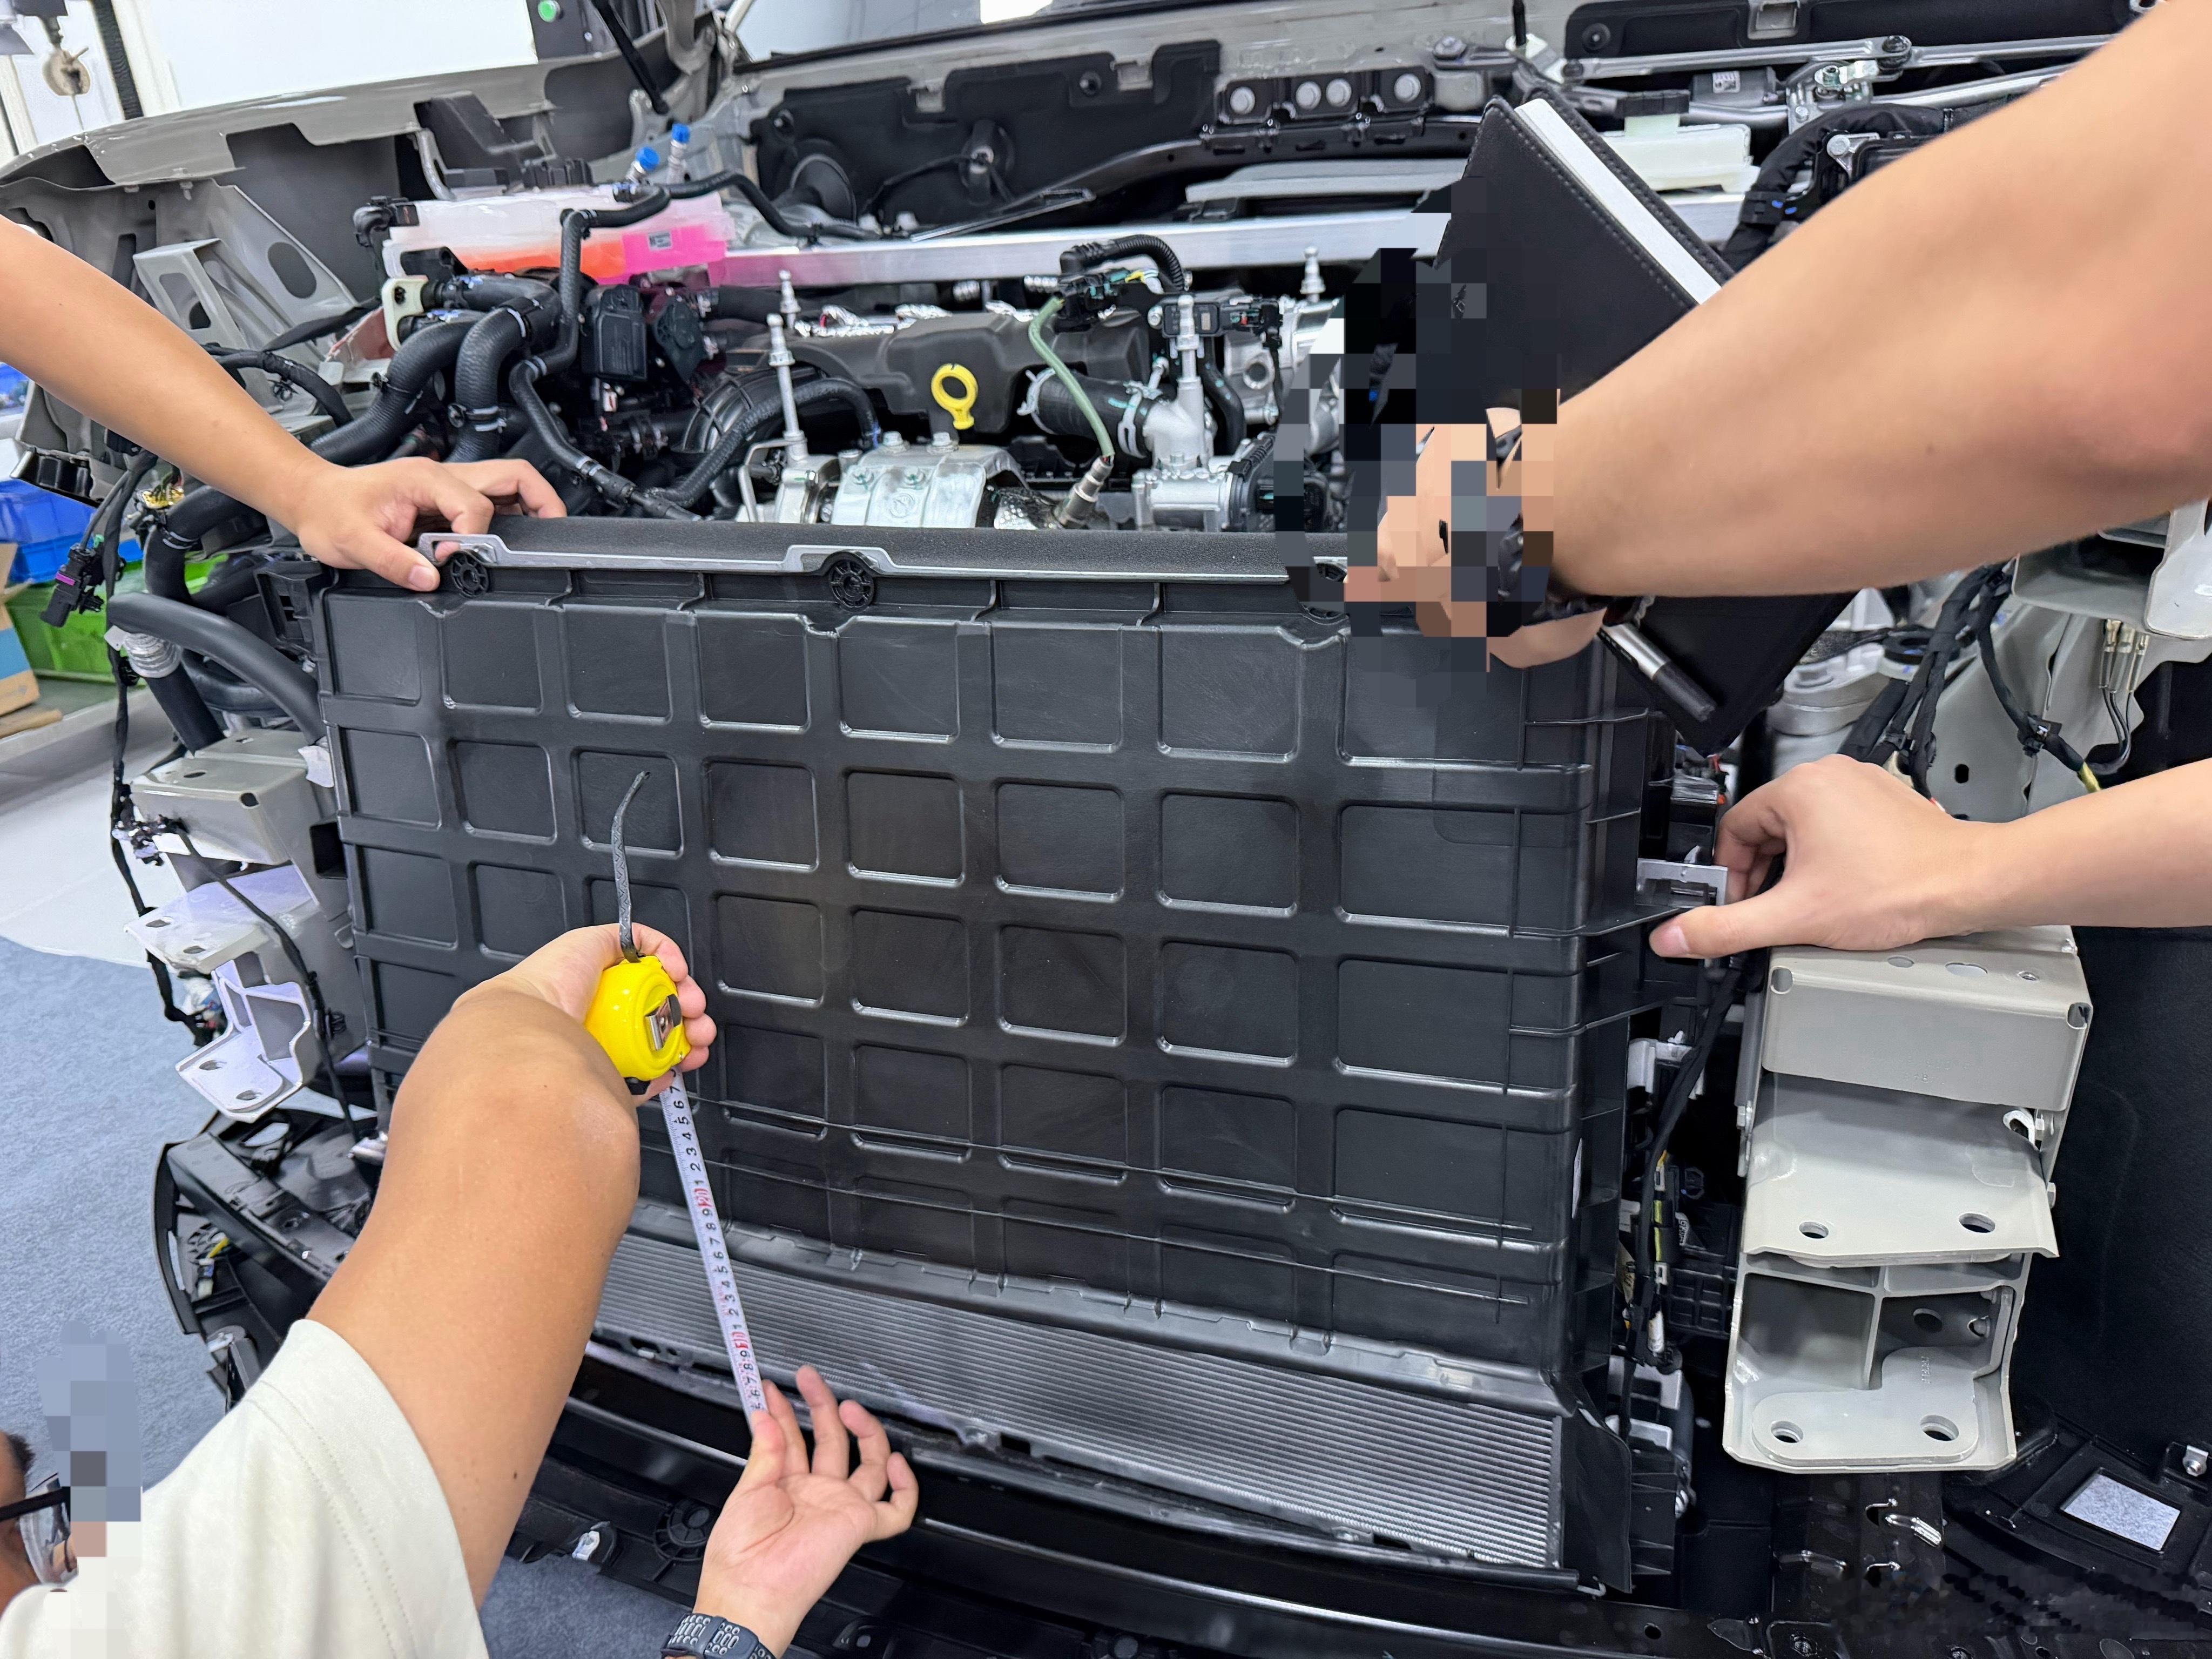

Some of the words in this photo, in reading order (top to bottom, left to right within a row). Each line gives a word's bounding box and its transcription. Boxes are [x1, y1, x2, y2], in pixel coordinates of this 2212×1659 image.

[670, 1085, 681, 1094] 7
[673, 1100, 684, 1109] 6
[678, 1116, 689, 1125] 5
[682, 1132, 691, 1140] 4
[686, 1147, 697, 1156] 3
[690, 1162, 701, 1171] 2
[702, 1209, 713, 1217] 9
[706, 1223, 716, 1231] 8
[717, 1265, 728, 1273] 5
[725, 1294, 736, 1302] 3
[729, 1309, 739, 1317] 2
